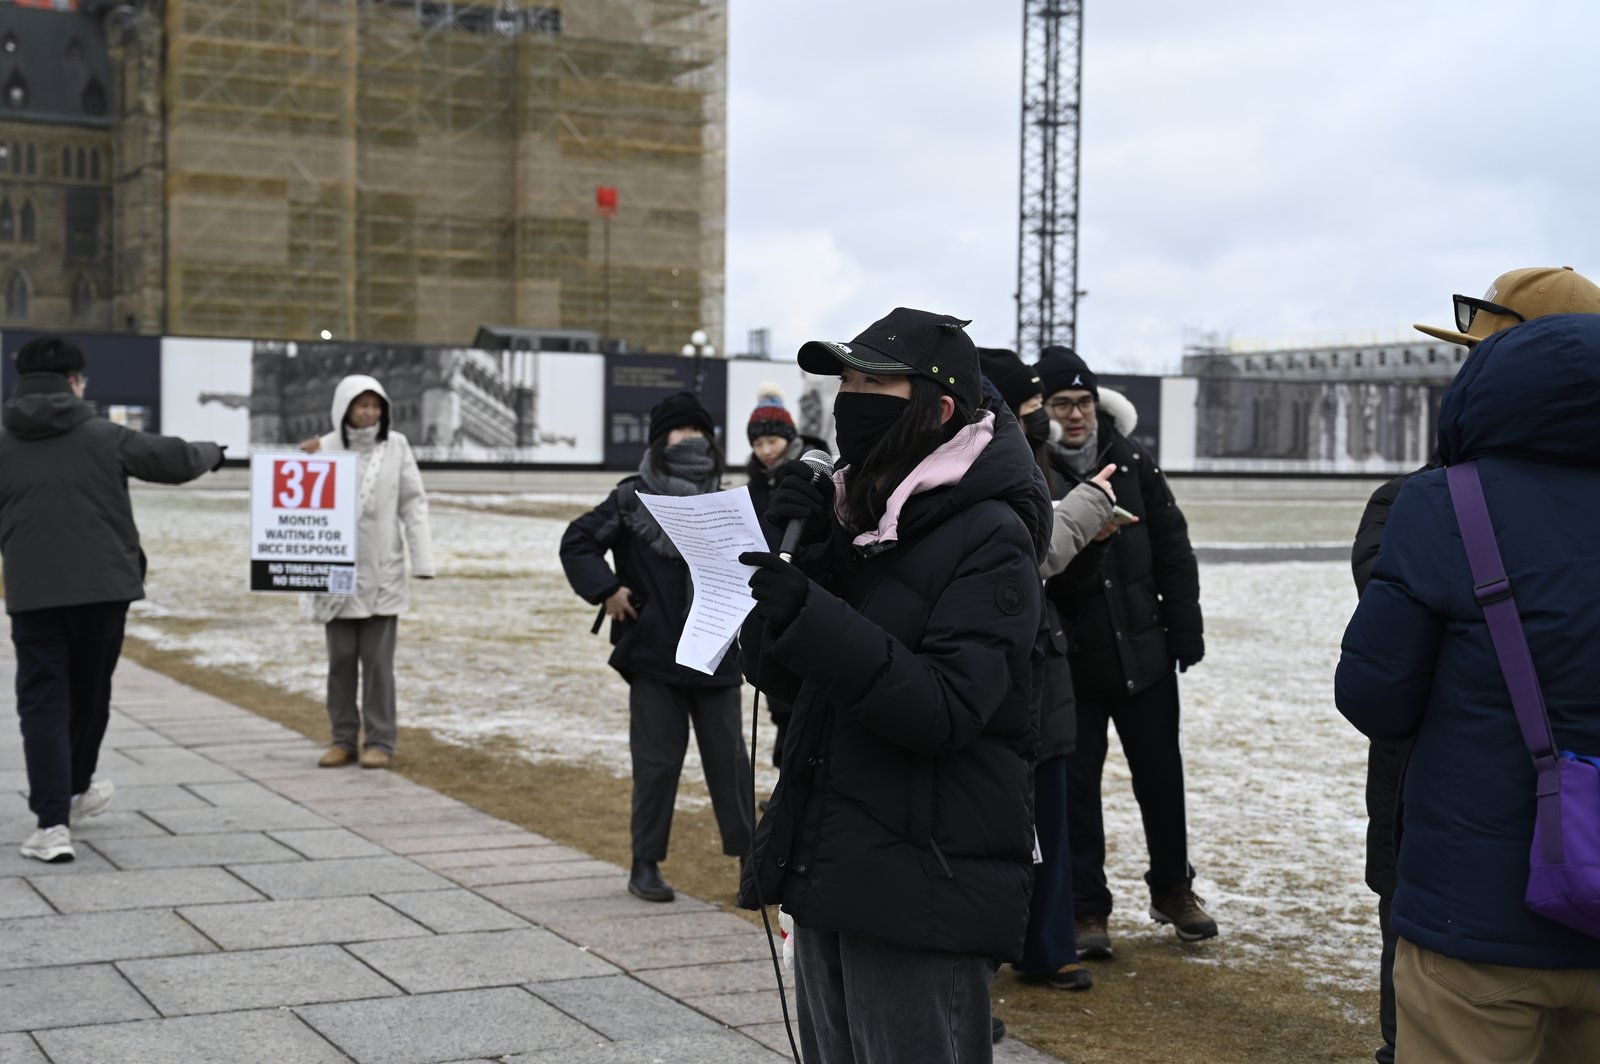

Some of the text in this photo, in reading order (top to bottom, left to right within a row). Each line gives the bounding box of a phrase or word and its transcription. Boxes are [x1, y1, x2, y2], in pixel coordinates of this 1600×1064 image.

[278, 461, 331, 509] 37
[278, 515, 329, 527] MONTHS
[265, 529, 342, 542] WAITING FOR
[257, 543, 348, 556] IRCC RESPONSE
[268, 563, 284, 574] NO
[272, 575, 288, 586] NO
